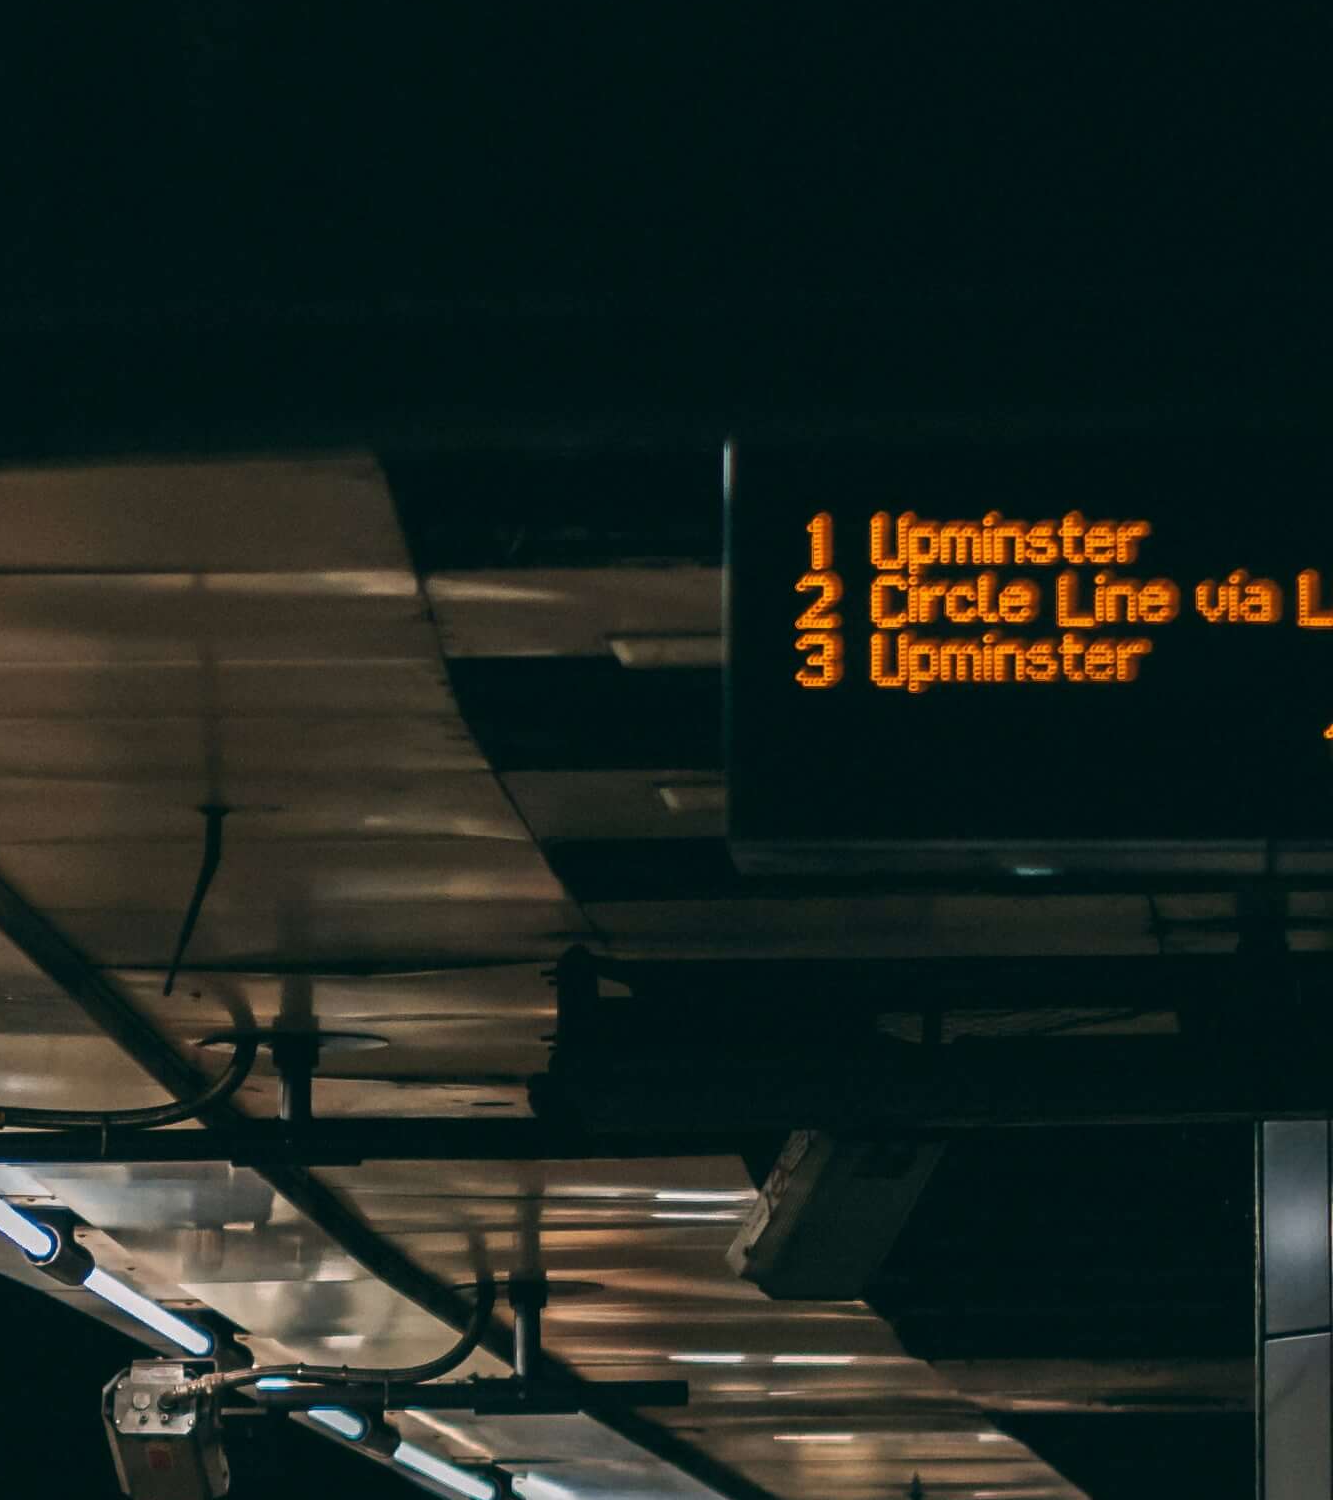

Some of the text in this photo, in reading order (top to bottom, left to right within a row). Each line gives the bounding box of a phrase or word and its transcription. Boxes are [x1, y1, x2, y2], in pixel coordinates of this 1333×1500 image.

[806, 511, 1149, 575] 1 Upminster
[794, 572, 841, 629] 2
[870, 571, 1036, 628] Circle
[1056, 570, 1177, 628] Line
[1195, 569, 1281, 624] via
[794, 632, 1150, 693] 3 Upminster
